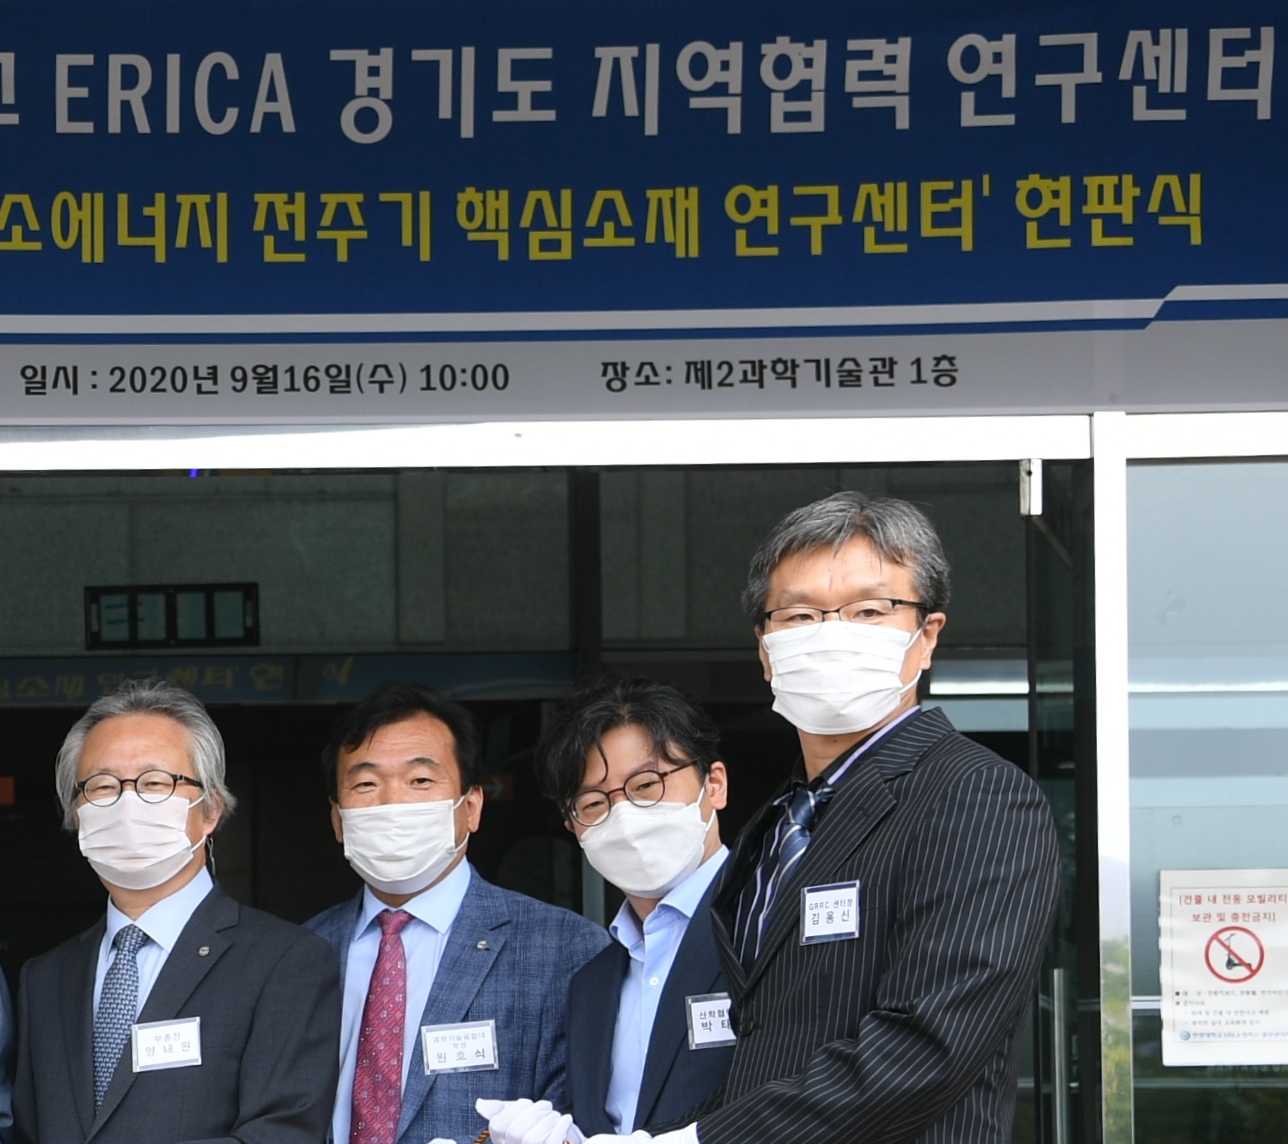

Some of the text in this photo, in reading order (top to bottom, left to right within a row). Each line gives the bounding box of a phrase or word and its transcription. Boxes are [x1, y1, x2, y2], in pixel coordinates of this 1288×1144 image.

[55, 53, 296, 136] ERICA
[329, 45, 557, 144] 경기도
[593, 36, 912, 137] 지역협력
[947, 27, 1274, 127] 연구센터
[252, 188, 431, 264] 전주기
[456, 186, 700, 261] 핵심소재
[724, 175, 991, 258] 연구센터'
[1015, 173, 1203, 250] 현판식
[20, 365, 79, 396] 일시
[109, 365, 219, 395] 2020년
[229, 363, 407, 395] 9월16일(수)
[420, 364, 510, 392] 10:00
[601, 360, 673, 392] 장소:
[684, 358, 898, 390] 제2과학기술관
[909, 354, 959, 387] 1층
[699, 1009, 730, 1020] 산학협
